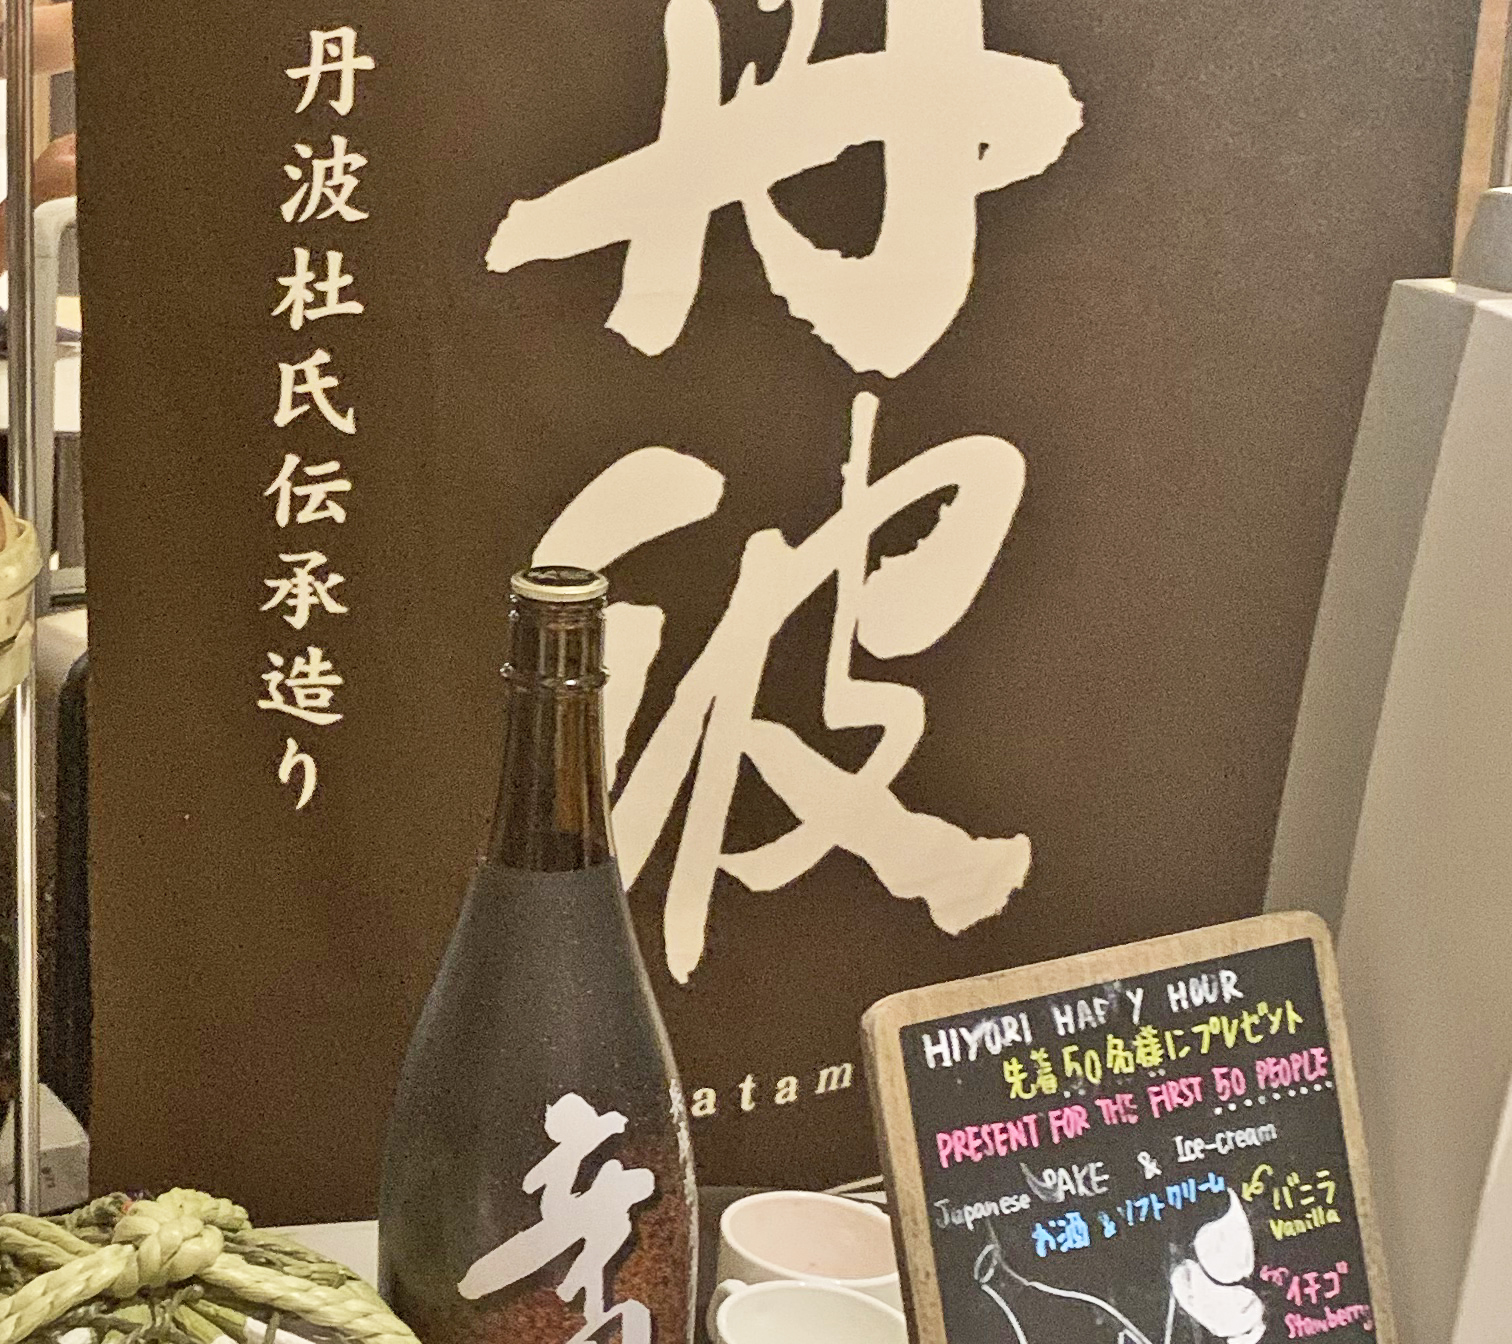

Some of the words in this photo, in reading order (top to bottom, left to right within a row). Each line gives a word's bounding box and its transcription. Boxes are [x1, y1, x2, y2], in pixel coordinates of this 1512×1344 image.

[256, 24, 377, 811] 丹波杜氏伝承造り
[922, 1011, 1032, 1070] HIYORI
[1167, 969, 1245, 1013] HOUR
[935, 1112, 1042, 1169] PRESENT
[1049, 1105, 1091, 1145] FOR
[1096, 1093, 1139, 1127] THE
[1146, 1075, 1205, 1119] FIRST
[1213, 1065, 1248, 1102] 50
[1255, 1047, 1331, 1091] PEOPLE
[933, 1193, 1033, 1231] Japanese
[1137, 1150, 1164, 1180] &
[1269, 1205, 1342, 1241] Vanilla
[1272, 1168, 1337, 1211] バニラ
[1286, 1260, 1350, 1307] イチゴ
